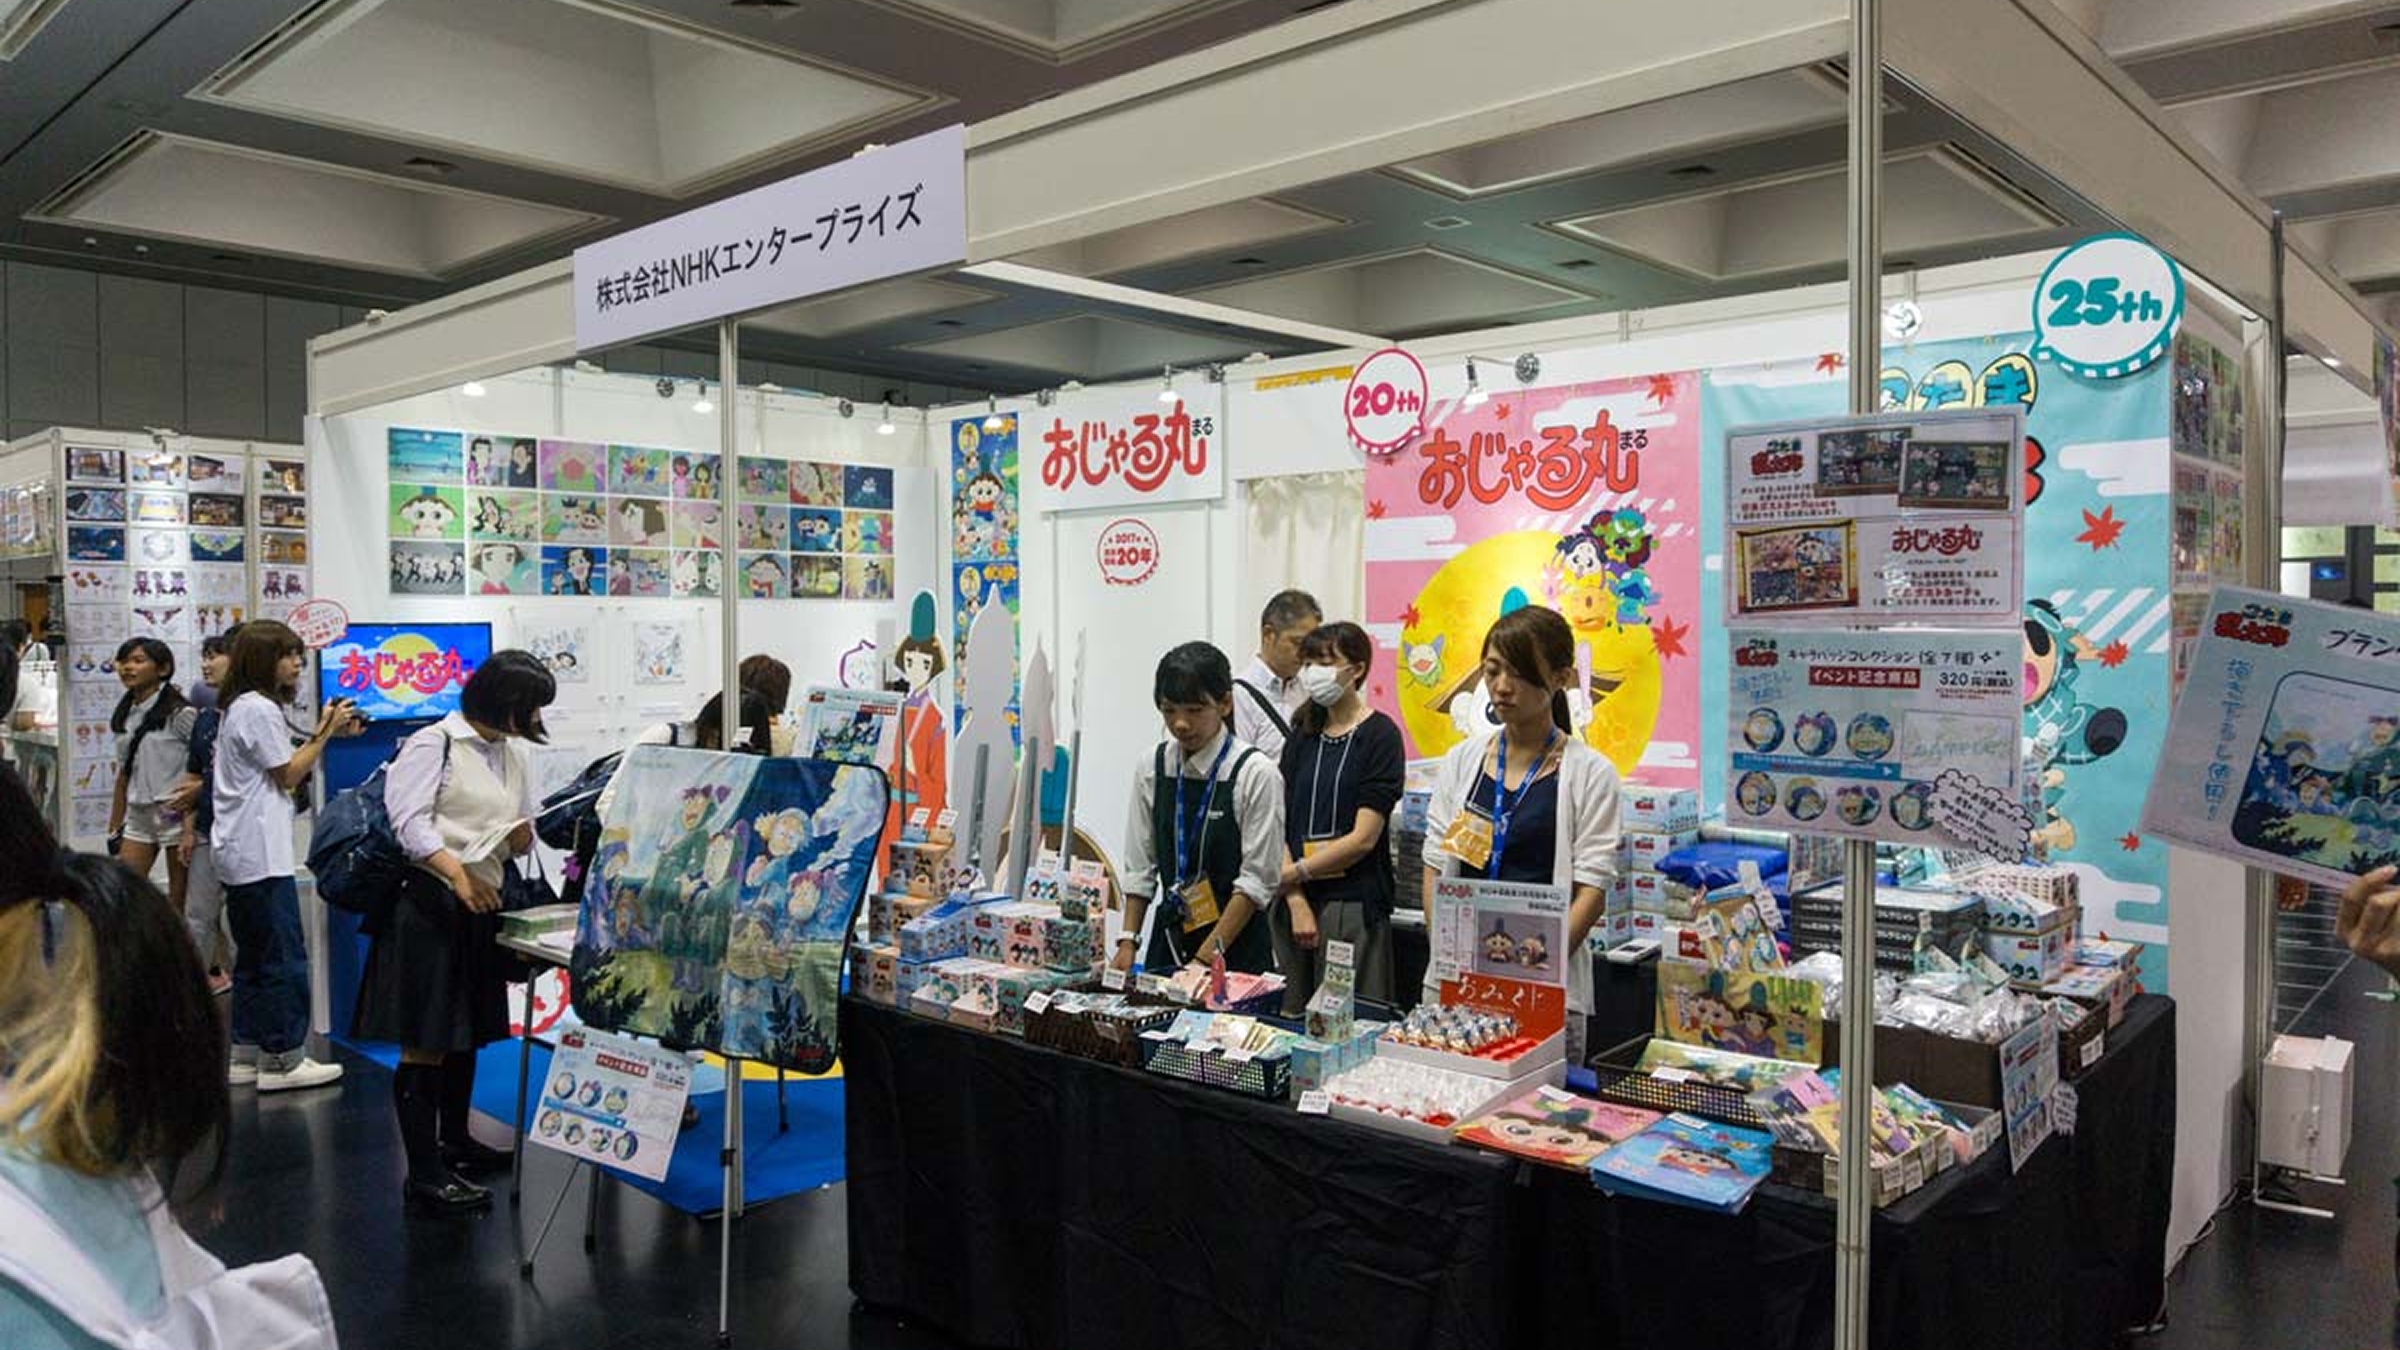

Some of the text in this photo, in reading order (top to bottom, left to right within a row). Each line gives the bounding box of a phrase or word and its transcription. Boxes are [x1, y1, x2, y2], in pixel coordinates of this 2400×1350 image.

[596, 182, 924, 312] 株式会社NHKエンタープライズ
[2047, 277, 2163, 328] 25th
[1353, 382, 1420, 418] 20th
[1042, 399, 1207, 492] おじゃる丸
[1619, 429, 1648, 450] まる
[1419, 409, 1639, 512] おじゃる丸
[1891, 523, 1980, 555] おじゃる丸
[2327, 629, 2400, 657] ブラン
[338, 647, 473, 694] おじゃる丸
[1813, 669, 1918, 686] イベント記念商品
[1458, 976, 1544, 1012] おみくじ
